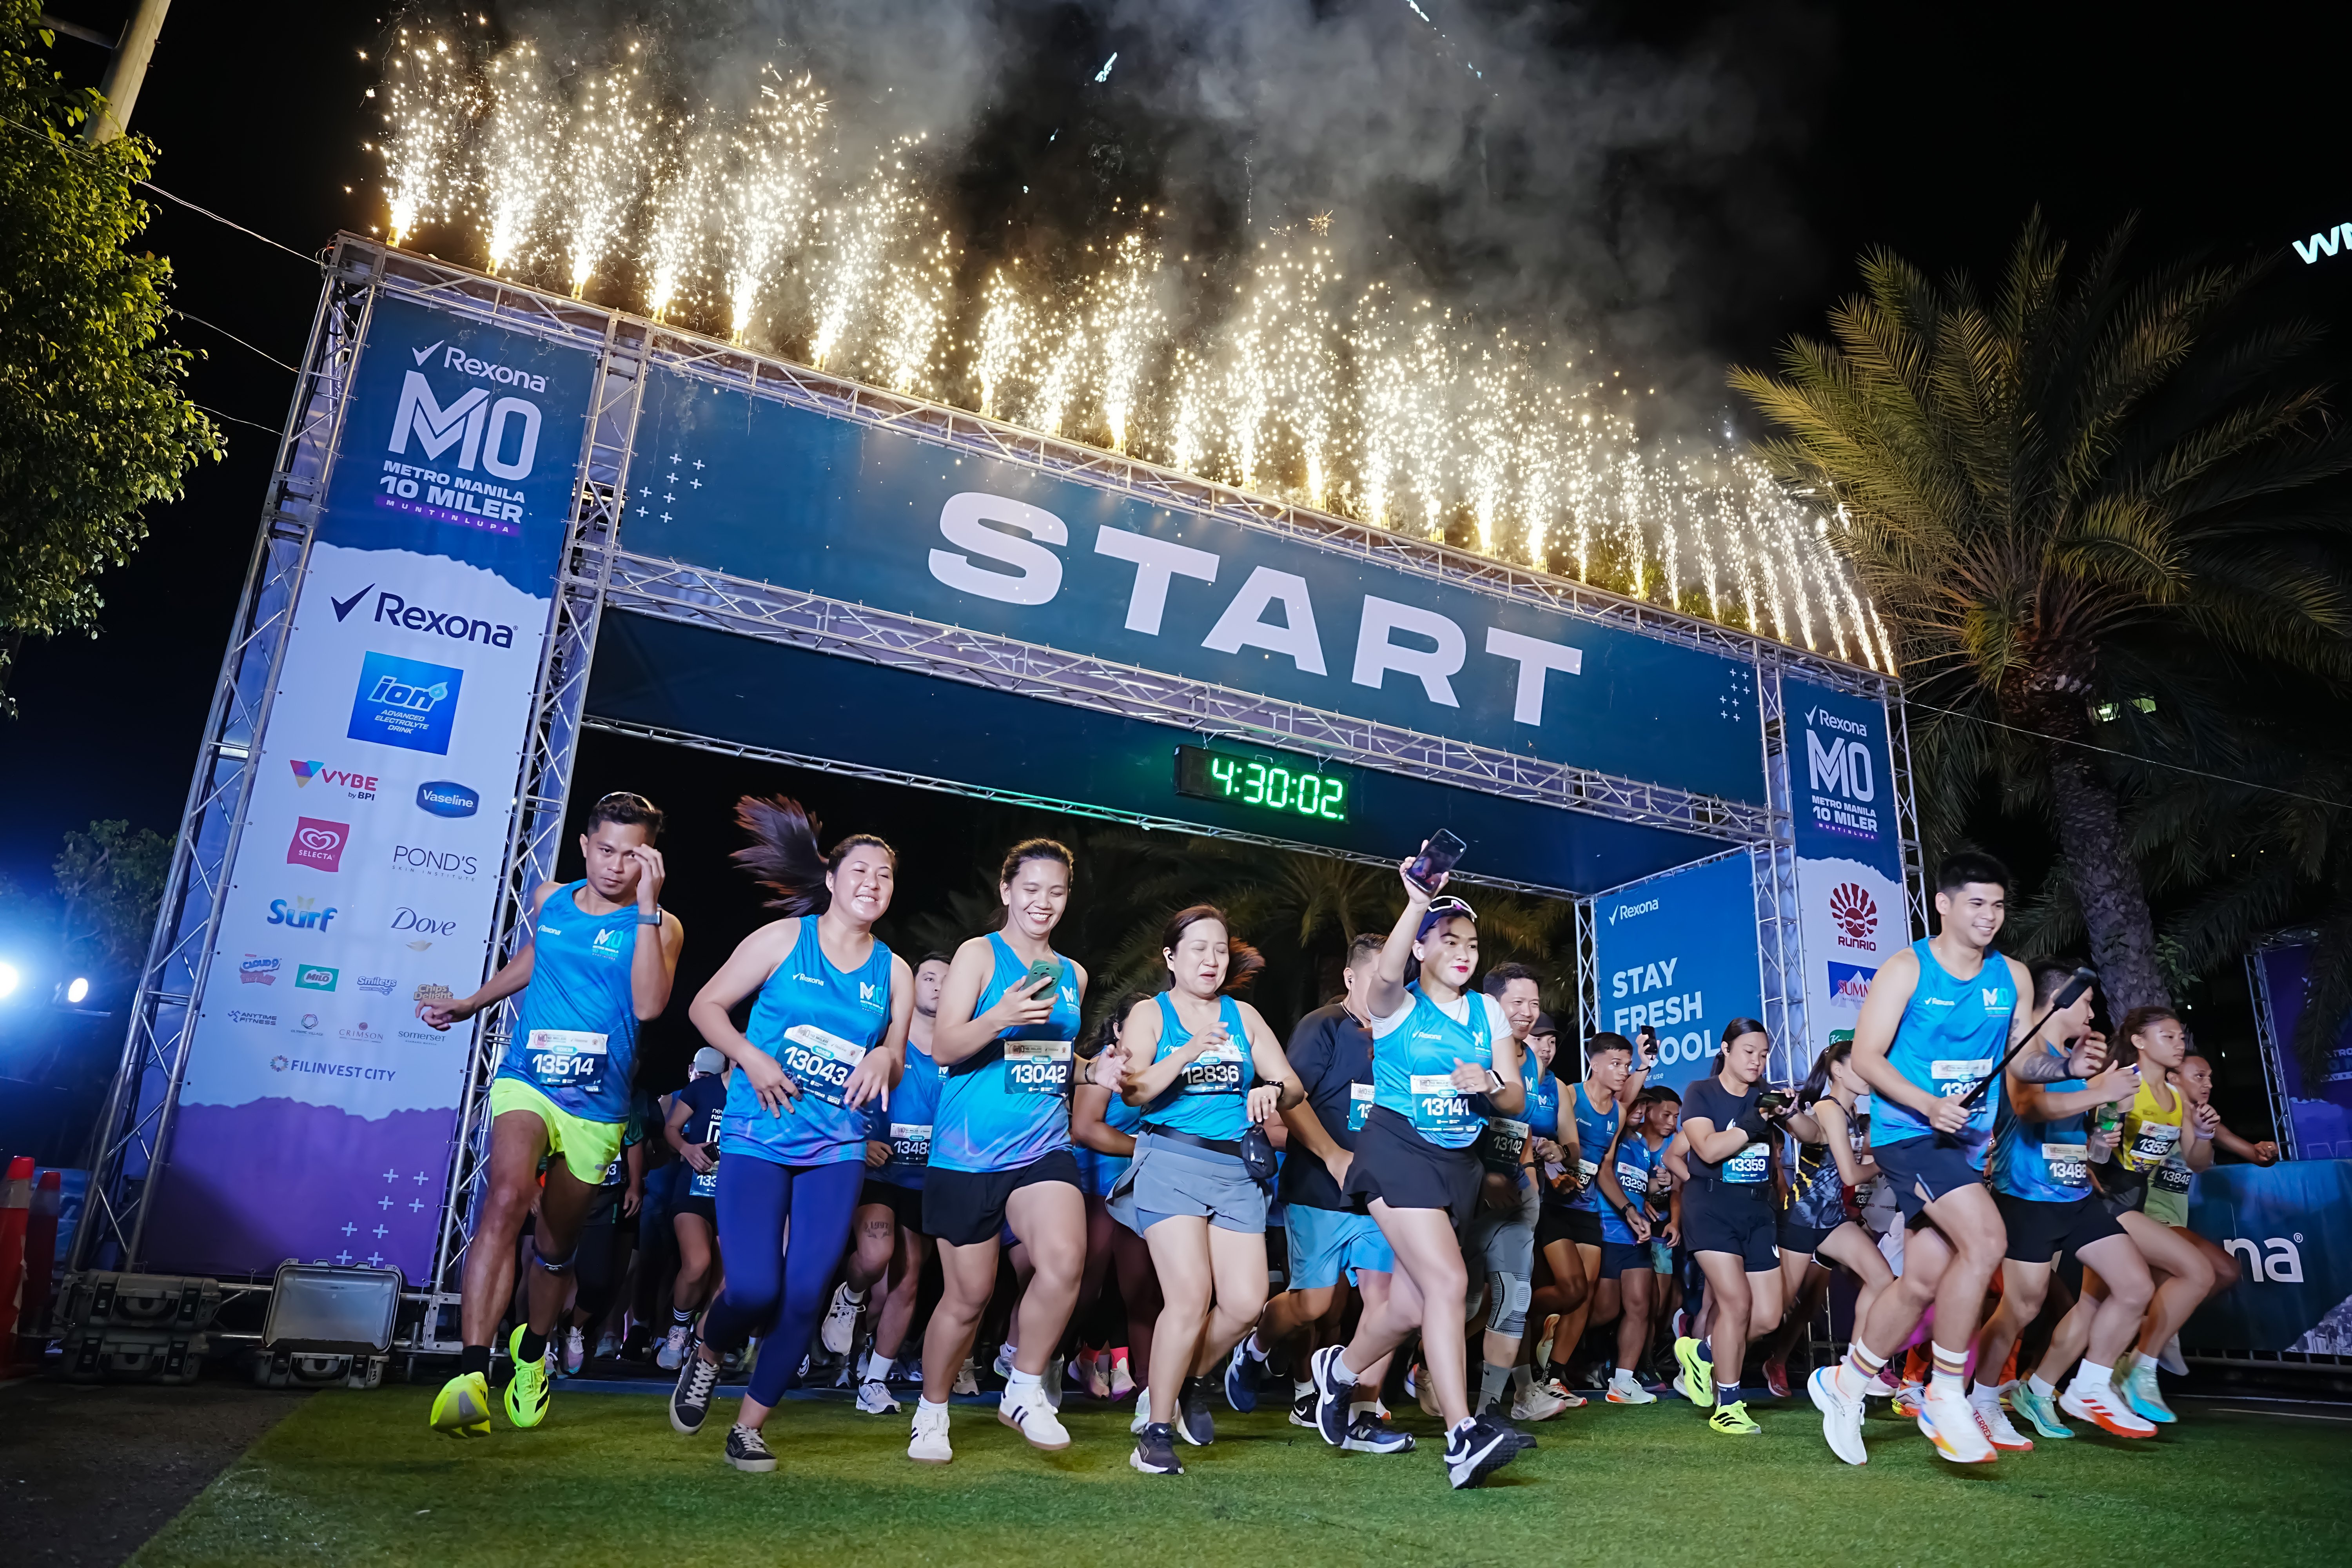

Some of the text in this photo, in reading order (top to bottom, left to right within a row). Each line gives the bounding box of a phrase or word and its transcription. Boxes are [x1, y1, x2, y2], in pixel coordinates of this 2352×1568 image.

[443, 346, 547, 393] Rexona
[383, 460, 525, 504] METRO MANILA
[380, 475, 523, 524] 10 MILER
[386, 500, 509, 533] MUNTINLUPA
[928, 492, 1583, 727] START
[374, 592, 513, 649] Rexona
[367, 675, 437, 711] ion
[374, 715, 430, 731] ELECTROLYTE
[381, 710, 425, 721] ADVANCED
[1819, 709, 1867, 737] Rexona
[387, 724, 414, 735] DRINK
[321, 769, 379, 791] VYBE
[357, 791, 375, 801] BPI
[423, 791, 474, 808] Vaseline
[1812, 795, 1876, 817] METRO MANILA
[1813, 806, 1878, 832] 10 MILER
[1819, 823, 1874, 839] MUNTINLUPA
[298, 850, 333, 860] SELECTA
[393, 846, 477, 875] POND'S
[423, 870, 475, 882] INSTITUTE
[267, 899, 338, 933] Surf
[1620, 898, 1659, 920] Rexona
[391, 907, 456, 936] Dove
[1838, 936, 1877, 951] RUNRIO
[306, 973, 330, 982] MILO
[357, 976, 397, 987] Smileys
[799, 973, 824, 986] Rexona
[1613, 957, 1677, 998] STAY
[414, 991, 453, 1001] Delight
[417, 984, 448, 993] Chips
[1838, 980, 1868, 998] SUMM
[240, 1017, 276, 1025] FITNESS
[1614, 991, 1703, 1035] FRESH
[339, 1029, 384, 1040] CRIMSON
[1648, 1029, 1721, 1069] OOL
[291, 1060, 396, 1082] FILINVEST CITY
[532, 1054, 594, 1075] 13514
[784, 1046, 848, 1086] 13043
[1011, 1065, 1067, 1083] 13042
[1181, 1065, 1239, 1084] 12836
[1422, 1098, 1470, 1116] 13141
[1494, 1136, 1523, 1154] 13142
[1728, 1159, 1766, 1171] 13359
[1620, 1176, 1647, 1192] 13290
[368, 1370, 377, 1382] 13
[1973, 1410, 1993, 1441] TERREX
